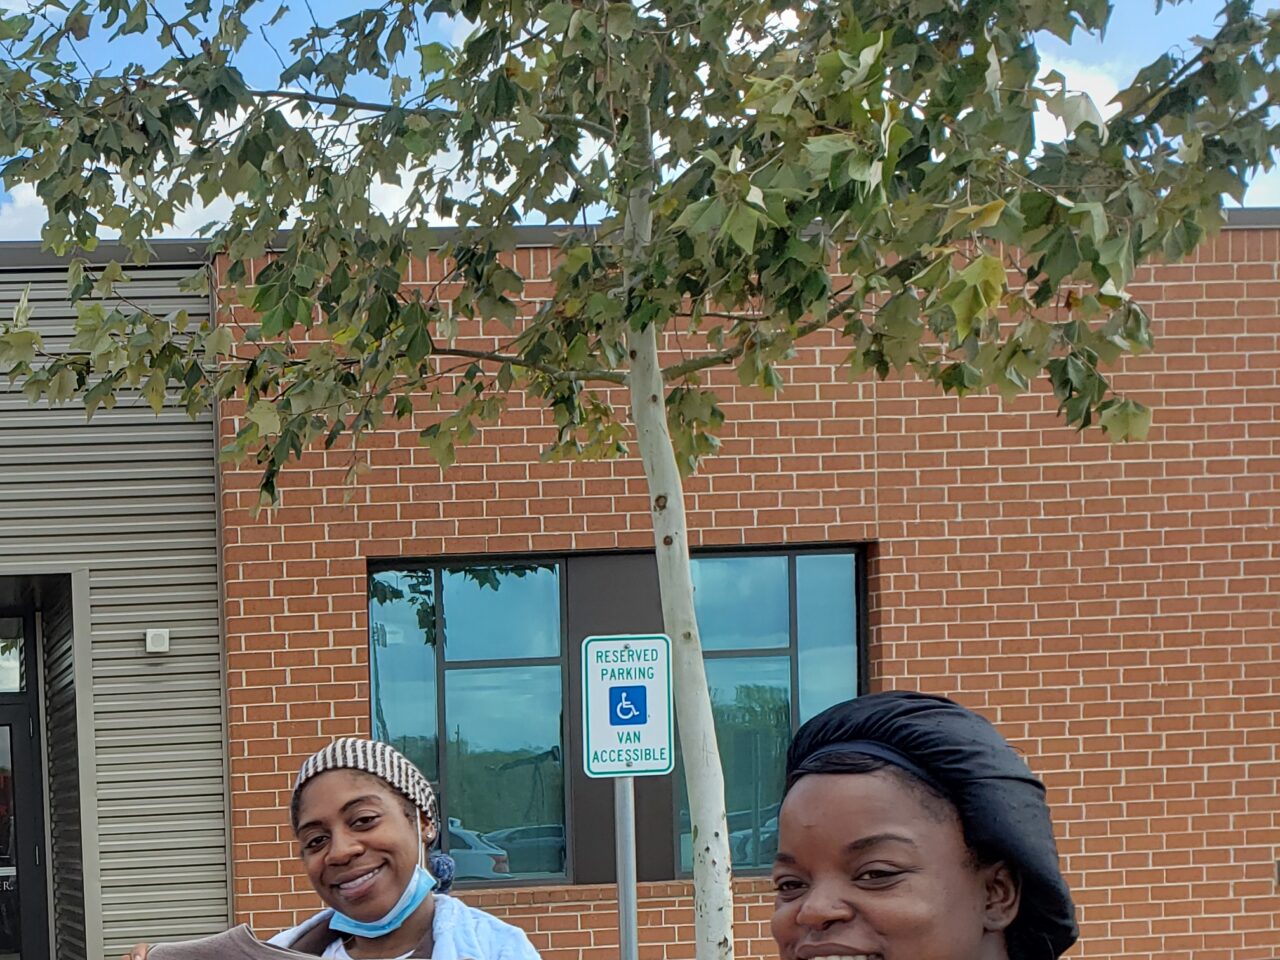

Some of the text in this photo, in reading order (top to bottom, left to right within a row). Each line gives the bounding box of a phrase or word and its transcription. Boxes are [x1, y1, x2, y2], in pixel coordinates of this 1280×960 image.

[596, 649, 659, 663] RESERVED
[601, 667, 654, 681] PARKING
[617, 731, 641, 744] VAN
[592, 748, 667, 763] ACCESSIBLE
